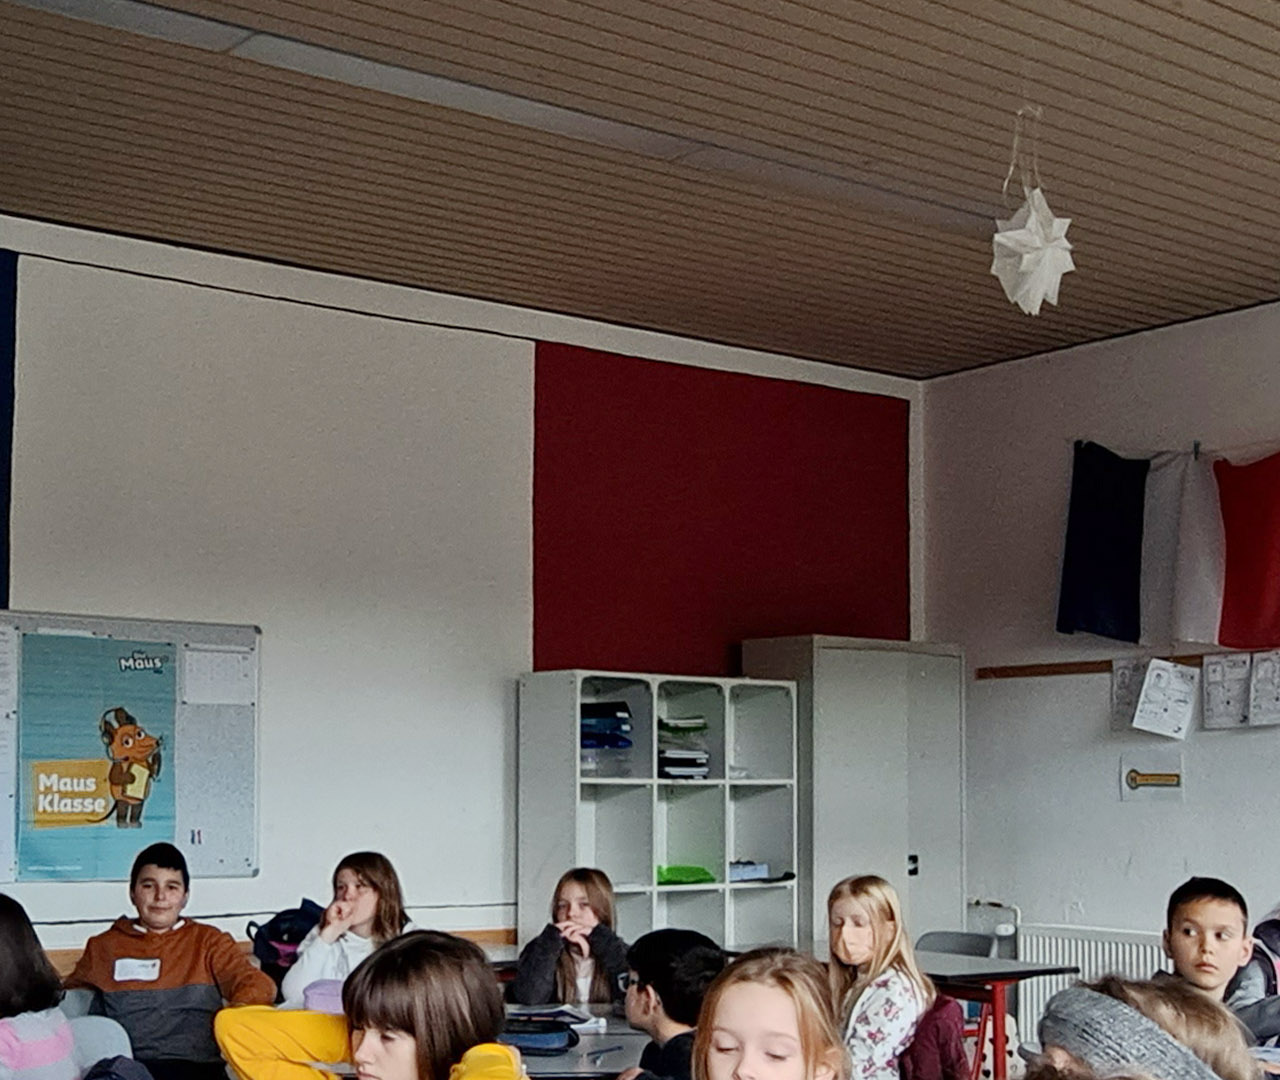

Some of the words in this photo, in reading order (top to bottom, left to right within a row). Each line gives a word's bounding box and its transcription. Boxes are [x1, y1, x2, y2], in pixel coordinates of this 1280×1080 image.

[120, 657, 162, 671] Maus
[38, 773, 97, 792] Maus
[37, 793, 106, 813] Klasse
